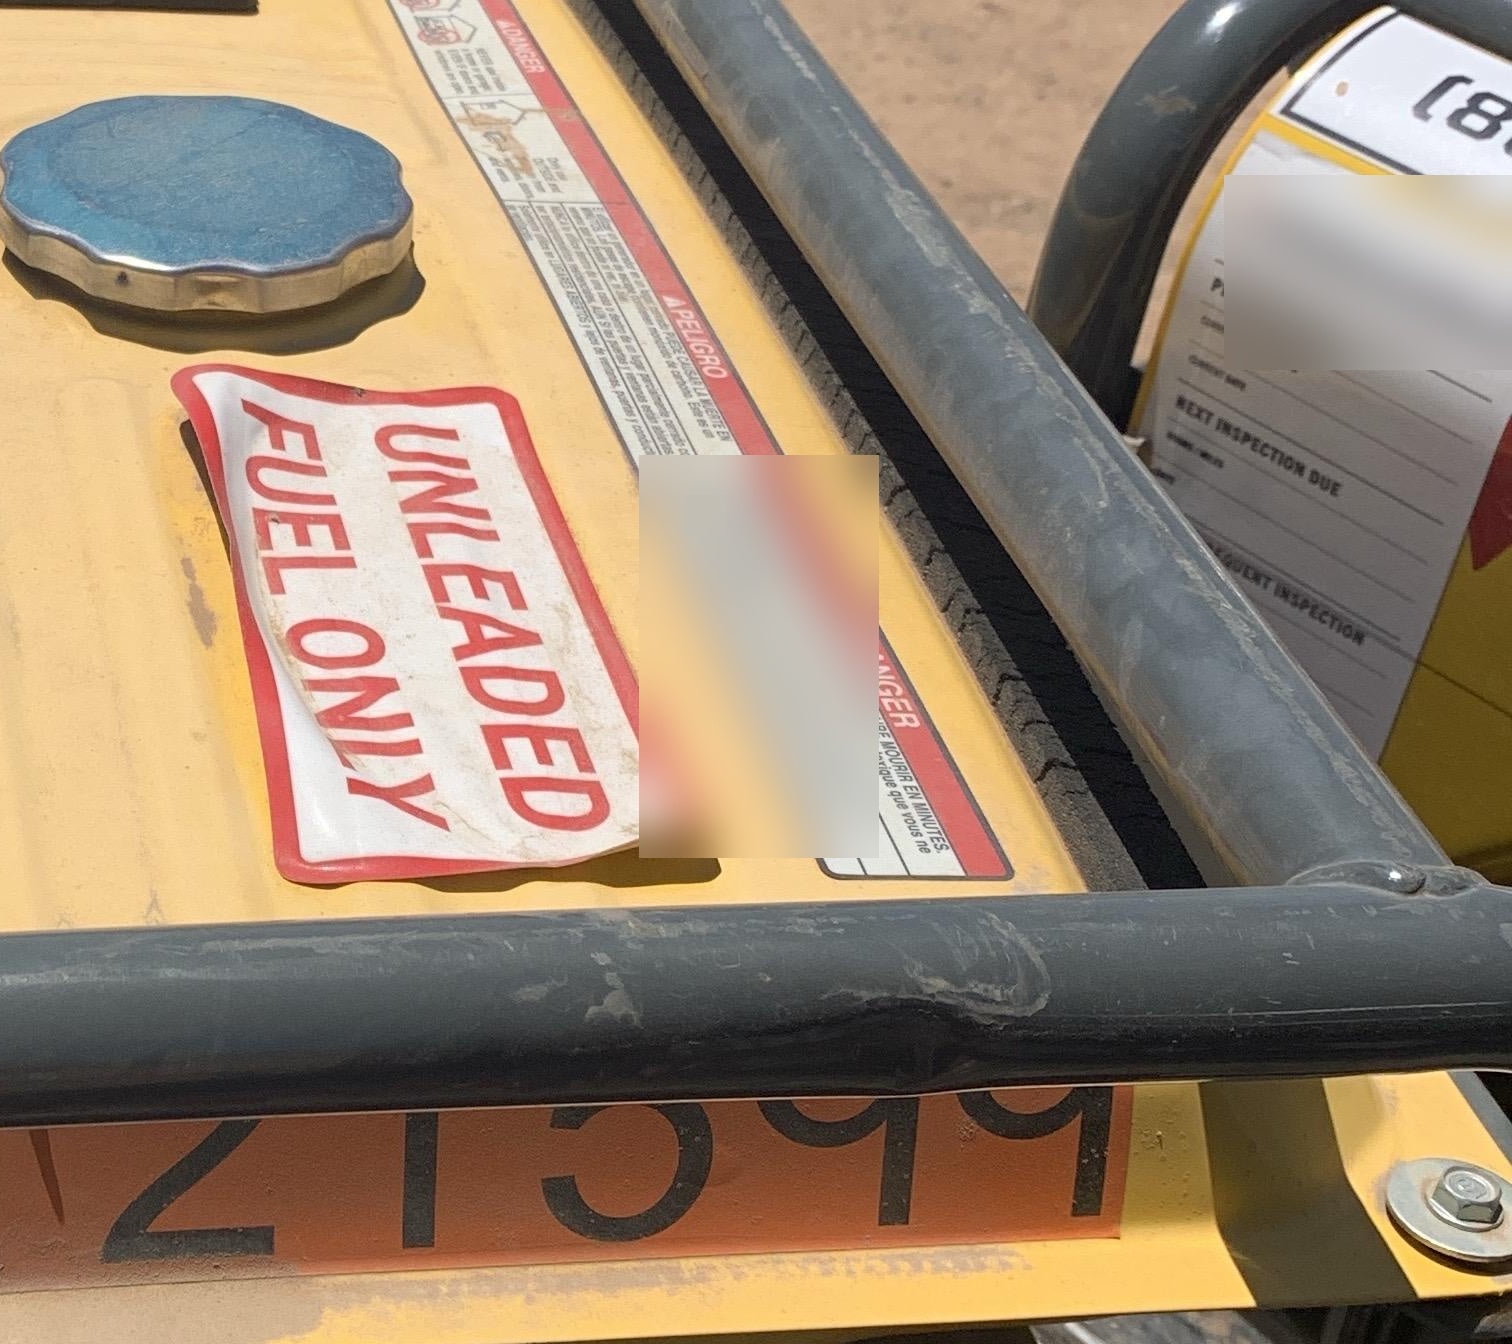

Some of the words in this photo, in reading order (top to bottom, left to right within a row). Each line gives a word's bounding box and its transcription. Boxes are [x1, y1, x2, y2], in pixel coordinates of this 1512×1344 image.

[503, 28, 545, 75] DANGER
[1412, 74, 1512, 157] (8
[667, 303, 728, 380] PELIGRO
[1175, 394, 1215, 426] NEXT
[1215, 416, 1307, 478] INSPECTION
[1308, 467, 1344, 498] DUE
[239, 397, 357, 596] FUEL
[374, 423, 610, 831] UNLEADED
[1273, 581, 1367, 646] INSPECTION
[286, 618, 451, 834] ONLY
[884, 741, 914, 784] MOURIR
[902, 784, 920, 800] EN
[913, 801, 951, 854] MINUTES.
[887, 788, 909, 811] que
[902, 812, 924, 838] vous
[915, 840, 932, 855] ne
